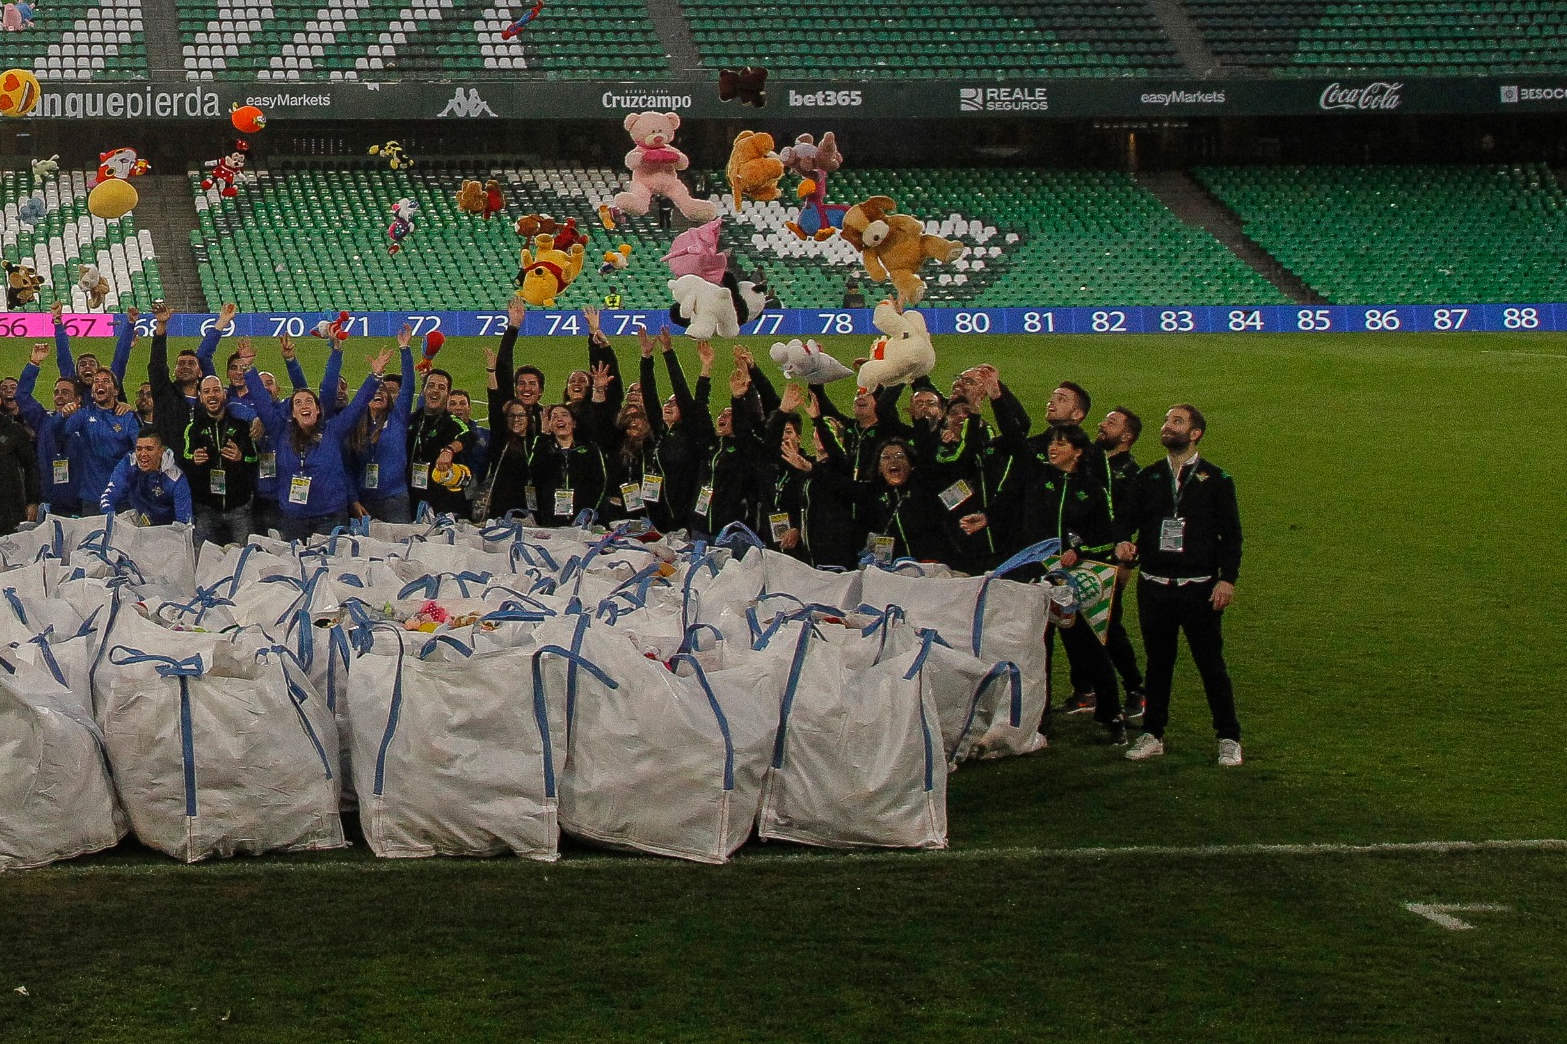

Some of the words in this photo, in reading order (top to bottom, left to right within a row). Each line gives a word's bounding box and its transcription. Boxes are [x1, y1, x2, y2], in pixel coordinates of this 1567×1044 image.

[245, 92, 331, 109] easyMarkets
[602, 91, 692, 111] Cruzcampo
[789, 90, 862, 106] bet365
[986, 88, 1047, 100] REALE
[1141, 90, 1226, 106] easyMarkets
[986, 101, 1049, 110] SEGUROS
[63, 317, 96, 337] 67
[270, 317, 304, 337] 70
[343, 316, 369, 336] 71
[407, 316, 441, 336] 72
[476, 315, 509, 335] 73
[545, 315, 580, 335] 74
[613, 314, 646, 335] 75
[818, 313, 853, 334] 78
[954, 312, 990, 333] 80
[1023, 312, 1054, 332] 81
[1091, 311, 1126, 332] 82
[1159, 310, 1194, 331] 83
[1228, 310, 1264, 331] 84
[1297, 309, 1331, 330] 85
[1364, 309, 1400, 330] 86
[1433, 308, 1468, 329] 87
[1502, 308, 1539, 329] 88
